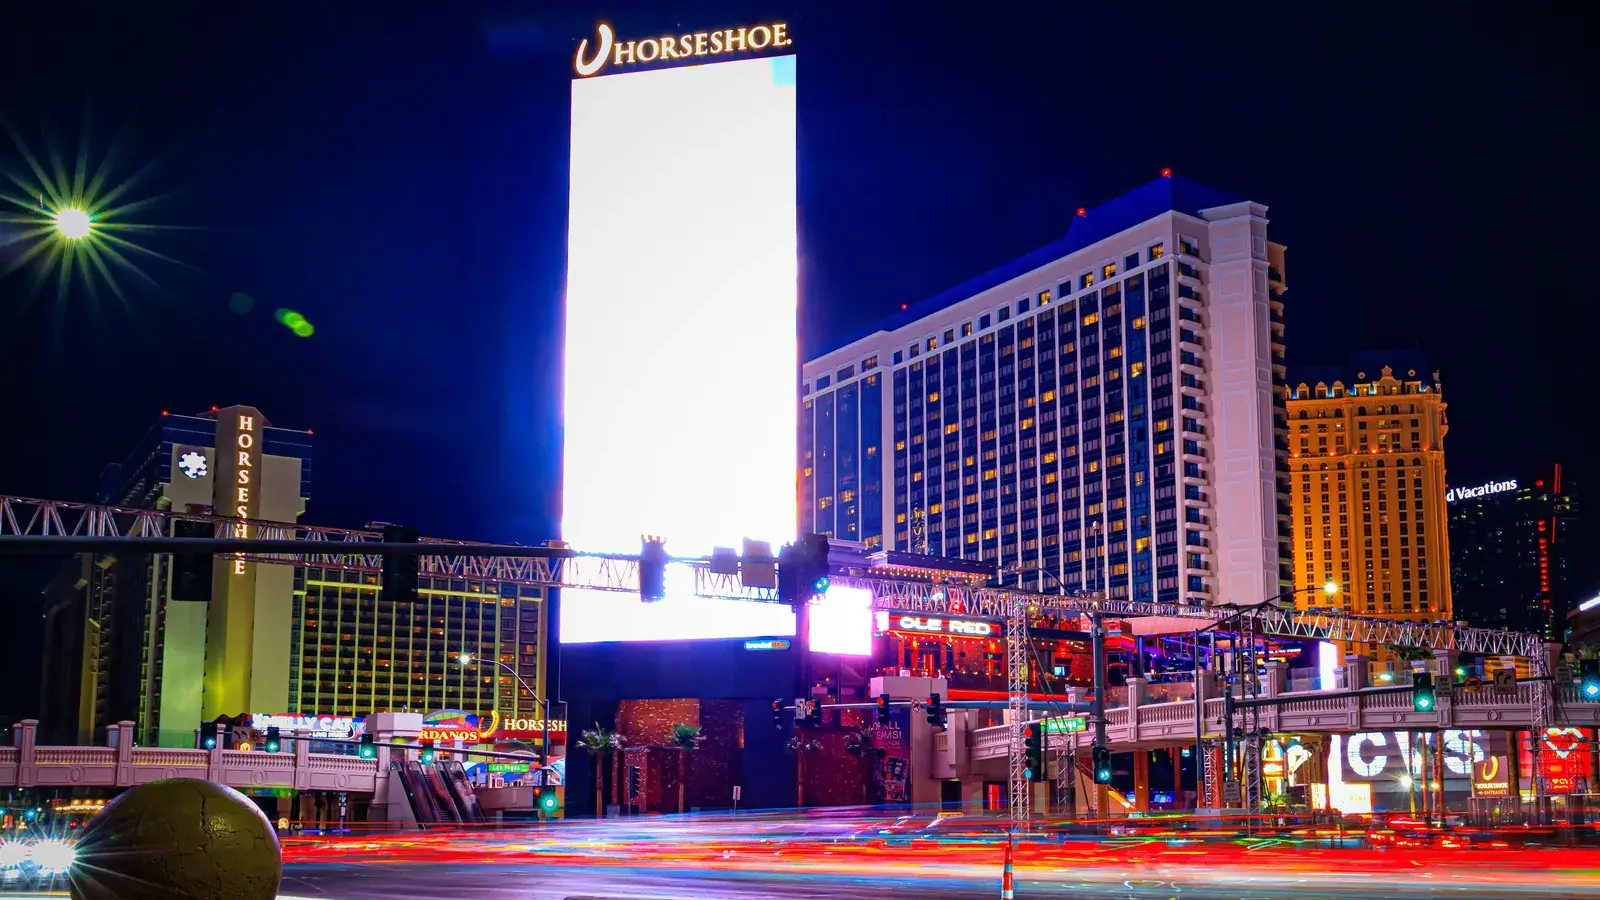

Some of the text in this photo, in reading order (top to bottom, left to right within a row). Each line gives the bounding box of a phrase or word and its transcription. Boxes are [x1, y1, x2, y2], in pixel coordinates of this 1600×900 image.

[234, 415, 253, 575] HORSESHE
[1456, 479, 1518, 500] Vacations
[900, 616, 991, 635] OLE RED
[320, 717, 353, 730] CAT
[1347, 731, 1484, 777] CVS
